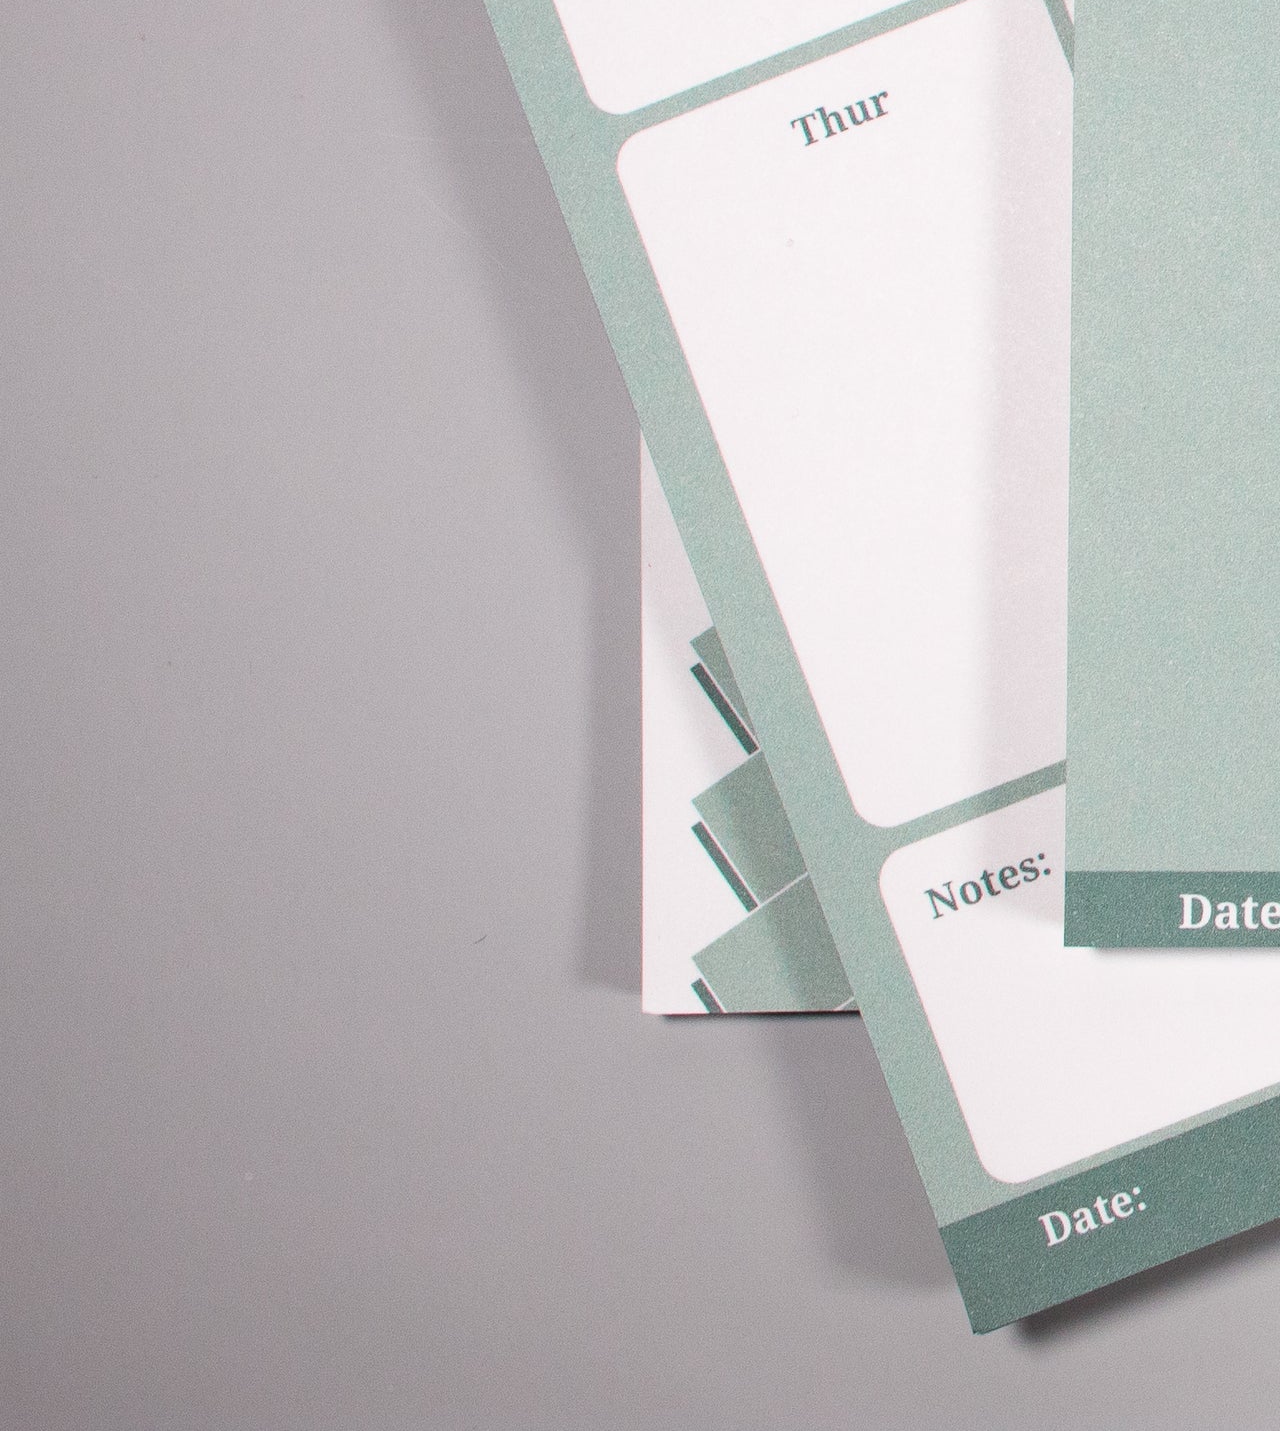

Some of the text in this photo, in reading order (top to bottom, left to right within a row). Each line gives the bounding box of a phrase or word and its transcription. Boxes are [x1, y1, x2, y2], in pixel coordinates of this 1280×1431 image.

[790, 86, 893, 147] Thur
[923, 851, 1052, 919] Notes:
[1038, 1185, 1147, 1246] Date:
